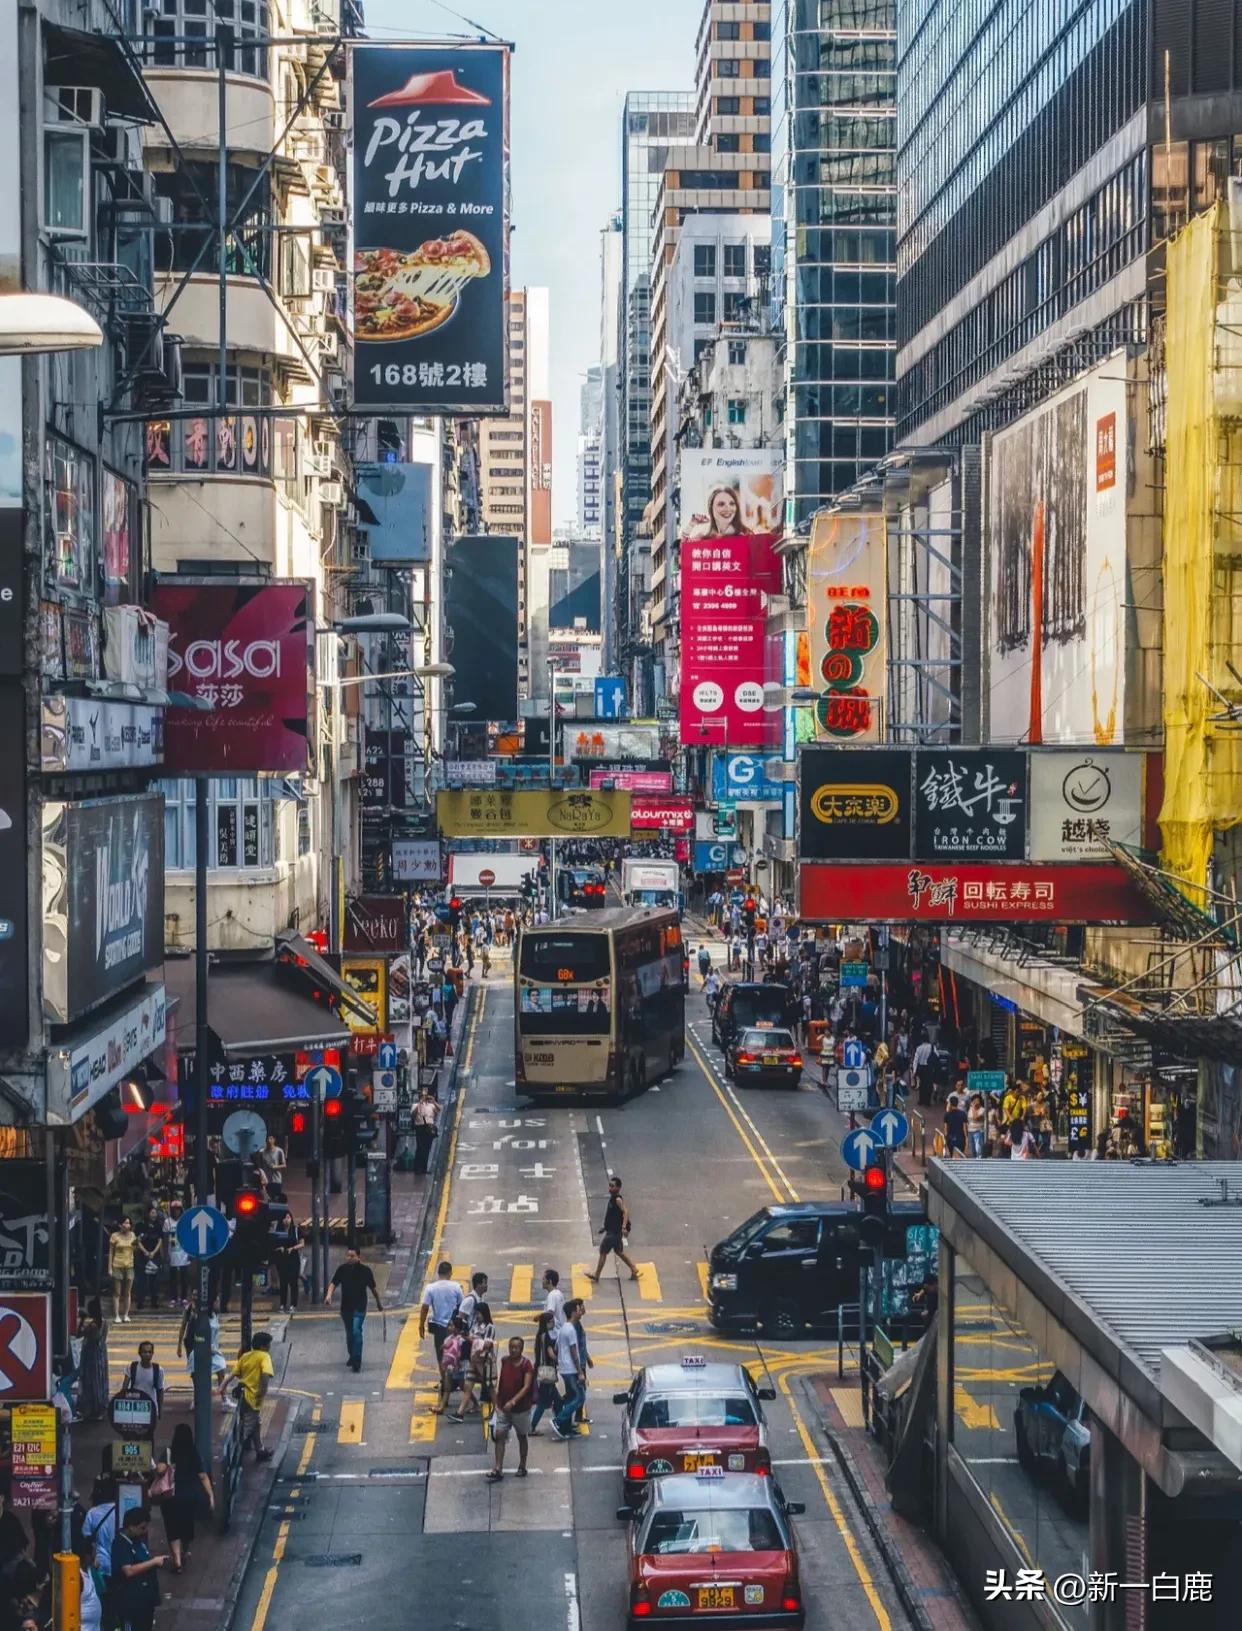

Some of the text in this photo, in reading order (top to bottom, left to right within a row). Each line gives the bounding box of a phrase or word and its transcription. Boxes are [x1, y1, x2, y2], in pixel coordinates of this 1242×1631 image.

[365, 110, 488, 168] Pizza
[384, 148, 483, 198] Hut
[410, 202, 443, 214] Pizza
[447, 202, 456, 214] &
[460, 203, 494, 214] More
[195, 682, 245, 709] 莎莎
[933, 835, 1007, 845] IRON COW
[963, 901, 1055, 910] SUSHI EXPRESS
[209, 1061, 288, 1084] 中西藥房
[684, 1357, 704, 1365] TAXI
[700, 1467, 723, 1477] TAXI
